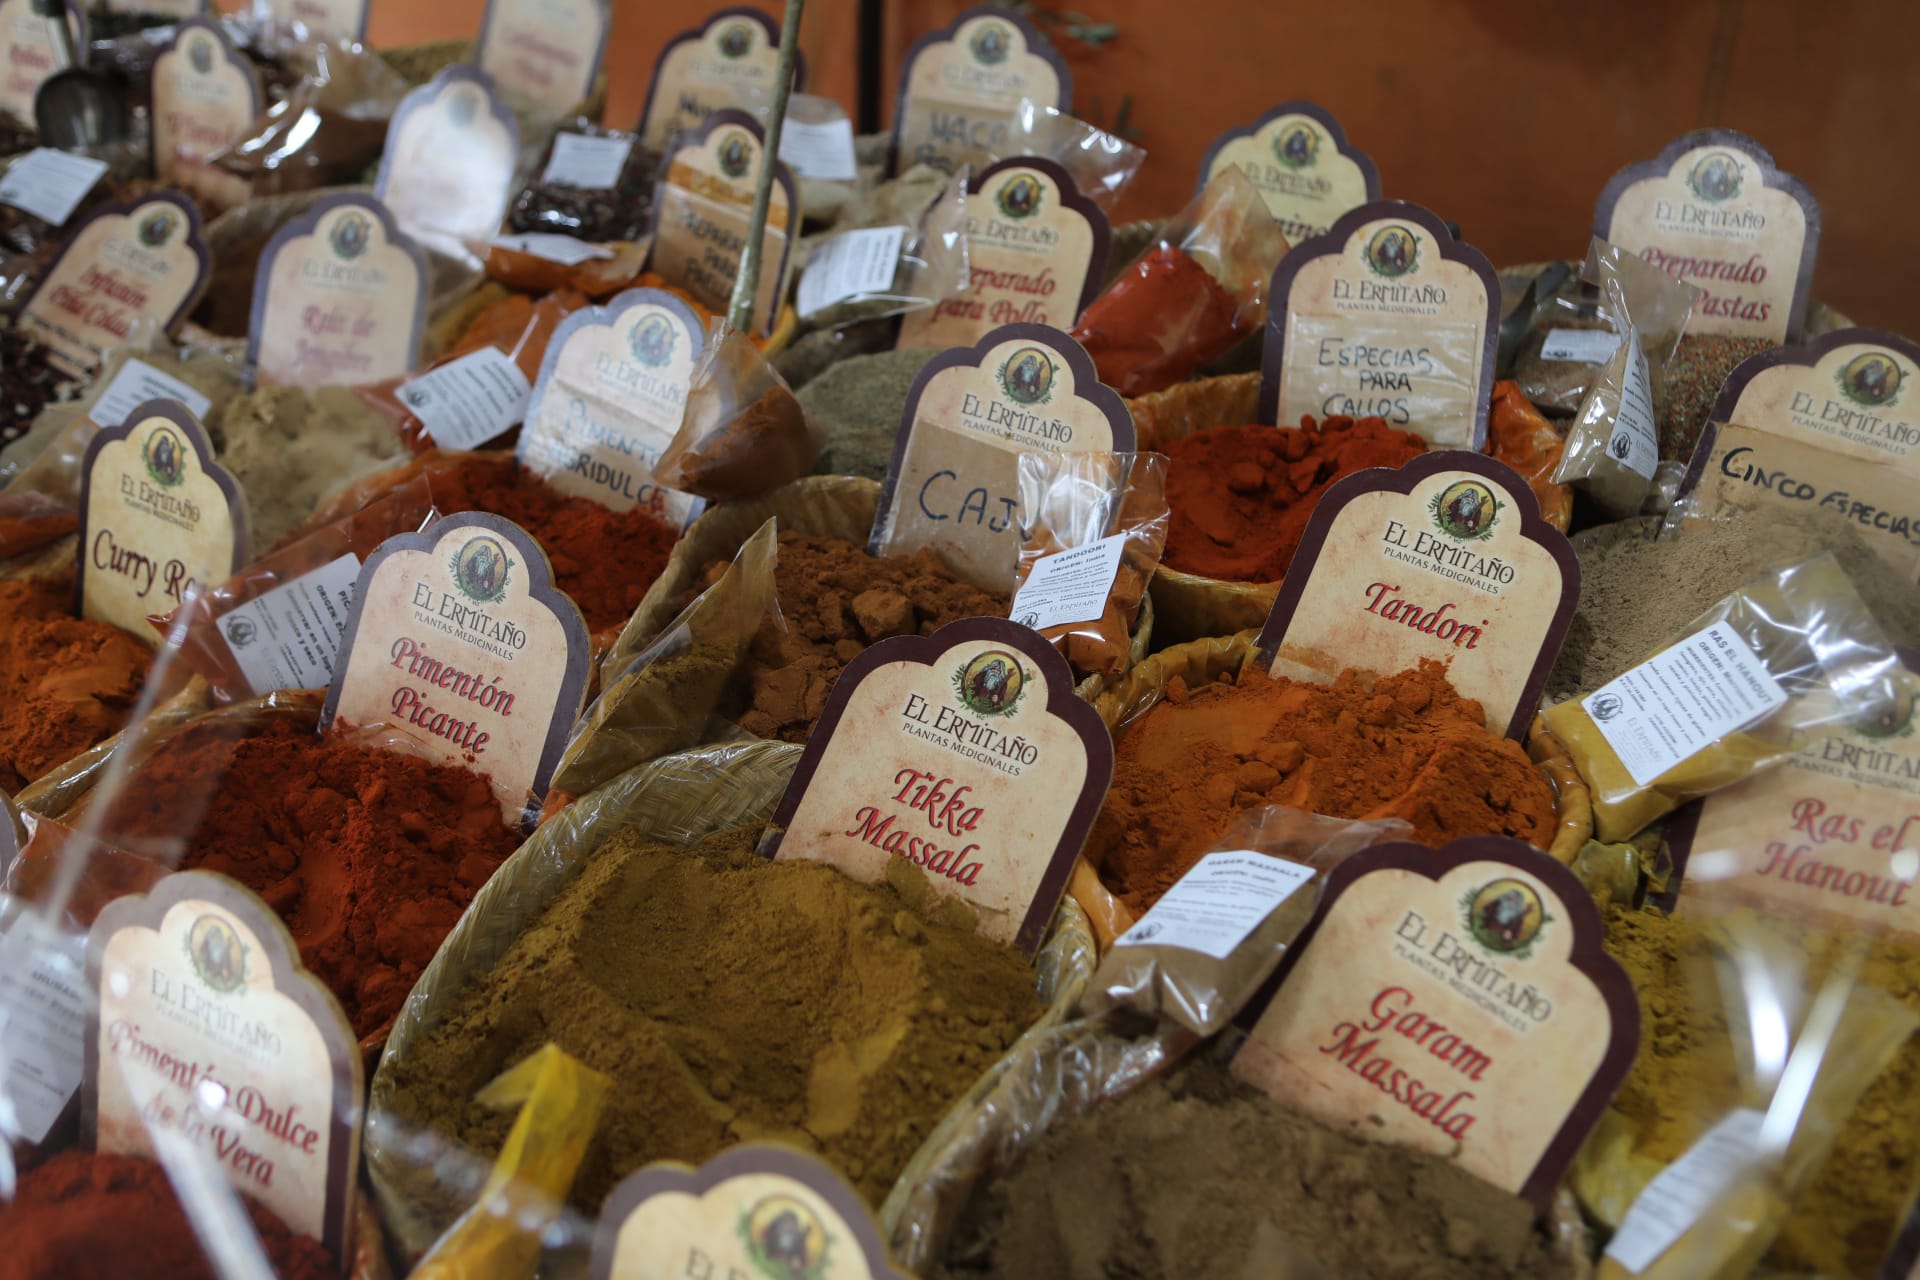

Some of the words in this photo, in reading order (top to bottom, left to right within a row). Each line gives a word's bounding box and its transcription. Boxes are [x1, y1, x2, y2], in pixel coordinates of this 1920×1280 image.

[1333, 278, 1354, 299] EL
[1639, 245, 1768, 285] Preparado
[1318, 336, 1433, 375] ESPECIAS
[1359, 368, 1413, 393] PARA
[961, 393, 983, 419] EL
[962, 418, 1001, 437] PLANTAS
[1789, 391, 1816, 417] EL
[1720, 446, 1817, 501] CINCO
[1053, 543, 1107, 565] TANDOORI
[1383, 520, 1409, 549] EL
[93, 528, 168, 598] Curry
[1383, 547, 1430, 569] PLANTAS
[1431, 563, 1500, 595] MEDICINALES
[411, 582, 435, 612] EL
[1364, 582, 1490, 651] Tandori
[414, 610, 454, 635] PLANTAS
[454, 627, 515, 662] MEDICINALES
[1708, 629, 1729, 650] RAS
[390, 636, 517, 717] Pimentón
[391, 686, 492, 754] Picante
[902, 693, 930, 725] EL
[903, 722, 949, 748] PLANTAS
[951, 741, 1022, 778] MEDICINALES
[891, 768, 985, 838] Tikka
[1790, 796, 1867, 845] Ras
[1871, 814, 1920, 855] el
[845, 806, 985, 887] Massala
[1755, 840, 1913, 908] Hanout
[1395, 909, 1428, 950] EL
[1361, 985, 1494, 1083] Garam
[1318, 1021, 1478, 1142] Massala
[237, 1085, 320, 1156] Dulce
[210, 1123, 276, 1187] Vera
